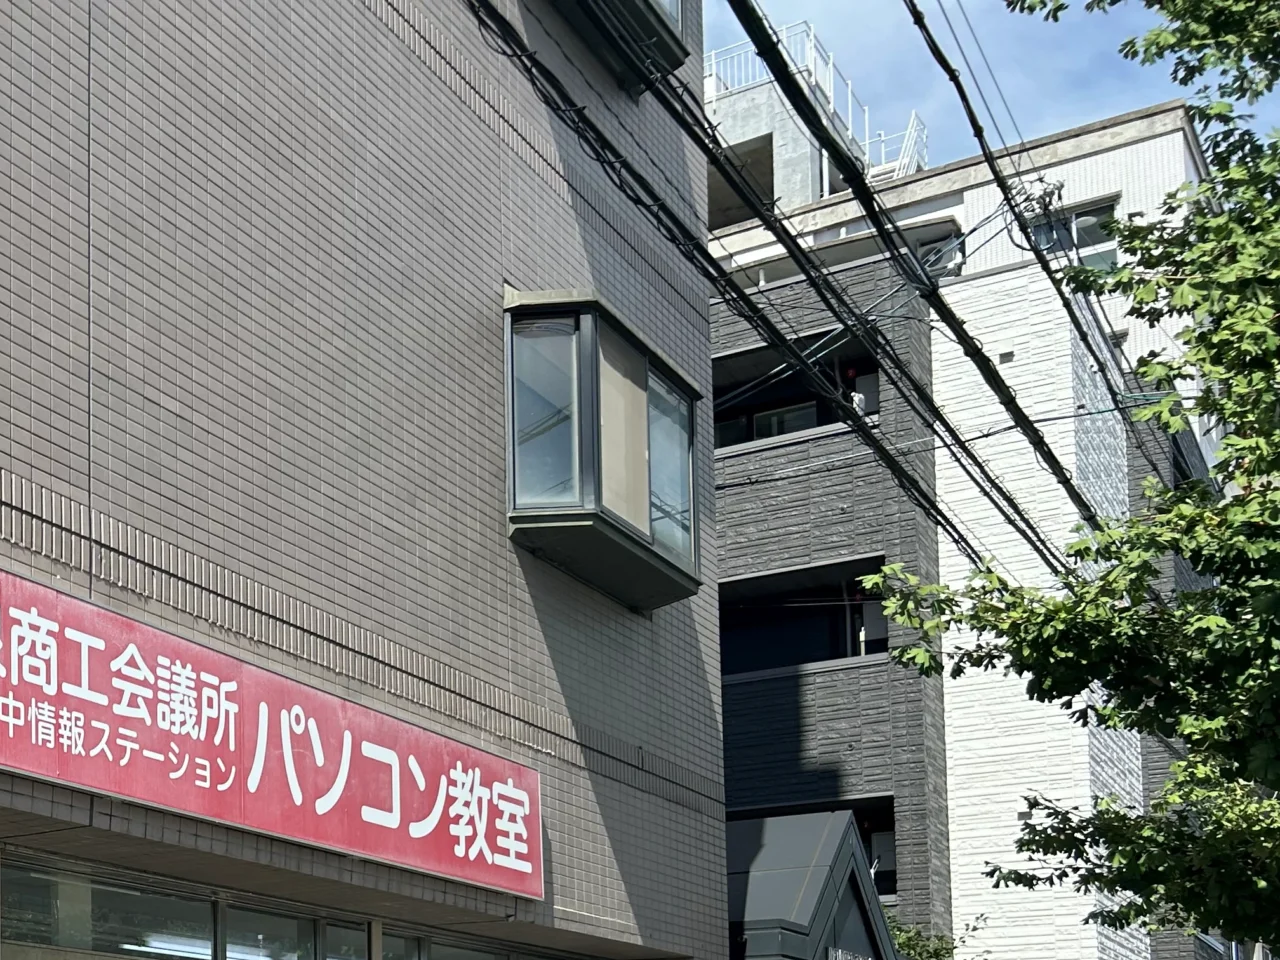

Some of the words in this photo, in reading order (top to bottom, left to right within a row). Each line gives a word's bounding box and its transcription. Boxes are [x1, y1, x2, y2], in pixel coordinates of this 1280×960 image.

[247, 701, 532, 874] パソコン教室
